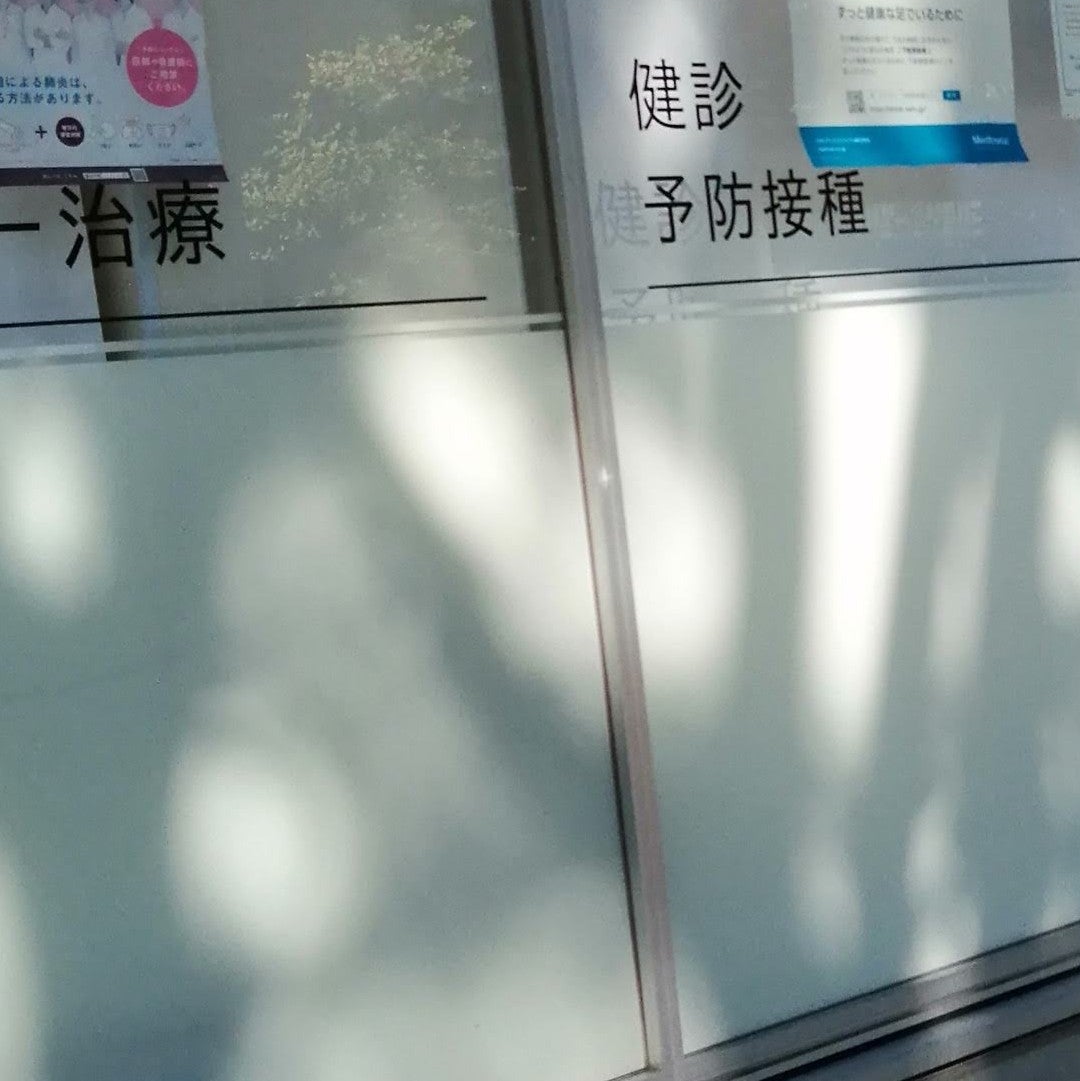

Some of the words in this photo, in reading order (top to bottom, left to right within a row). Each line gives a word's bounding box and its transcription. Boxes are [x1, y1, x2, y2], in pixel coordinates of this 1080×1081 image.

[628, 57, 744, 131] 健診
[644, 169, 870, 244] 予防接種
